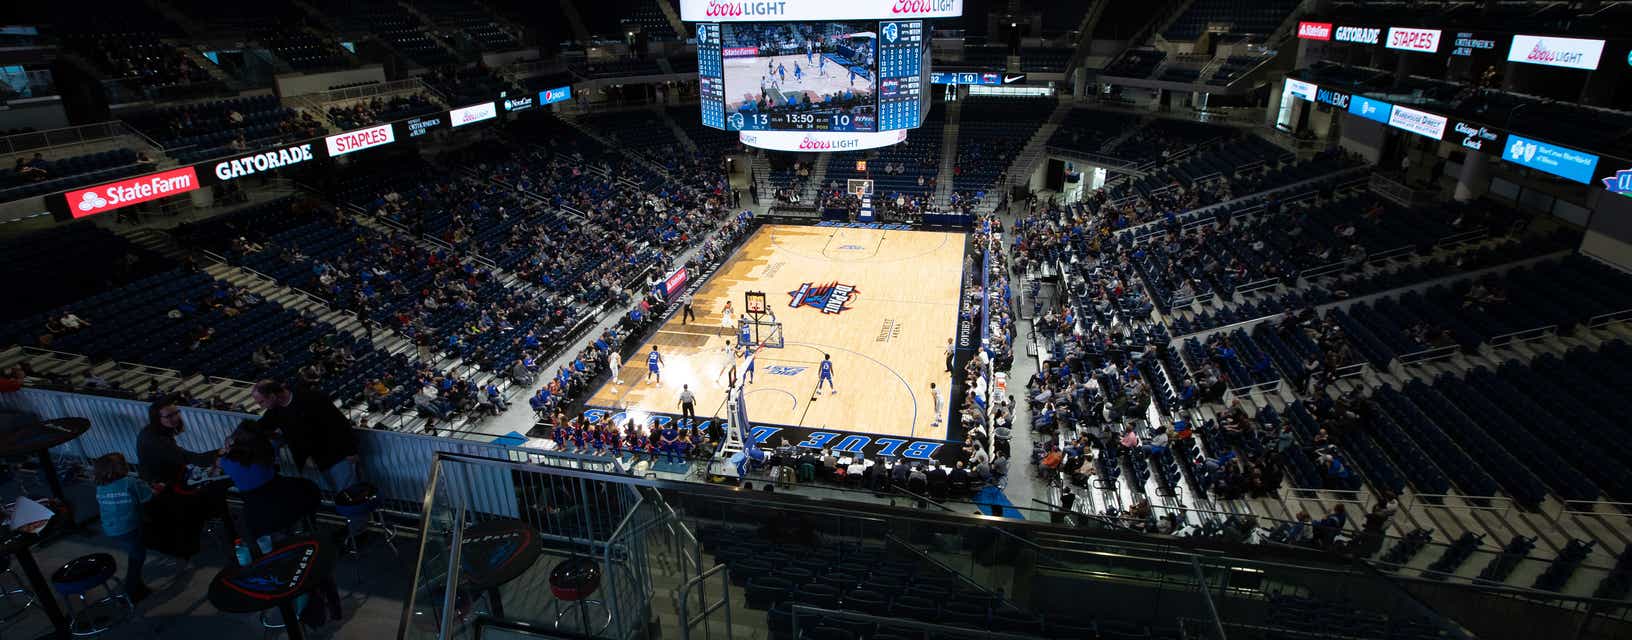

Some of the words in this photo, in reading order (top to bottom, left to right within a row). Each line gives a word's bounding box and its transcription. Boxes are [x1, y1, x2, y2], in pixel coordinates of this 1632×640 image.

[705, 0, 742, 17] Coors
[744, 1, 787, 16] LIGHT
[1335, 26, 1380, 44] GATORADE
[1393, 31, 1433, 49] STAPLES
[1555, 51, 1583, 65] LIGHT
[752, 114, 768, 125] 13
[785, 114, 814, 123] 13:50
[833, 115, 850, 126] 10
[335, 128, 387, 152] STAPLES
[799, 137, 831, 150] Coors
[831, 138, 859, 148] LIGHT
[215, 144, 313, 180] GATORADE
[960, 320, 971, 347] CHICAGO
[799, 431, 944, 460] BLUE
